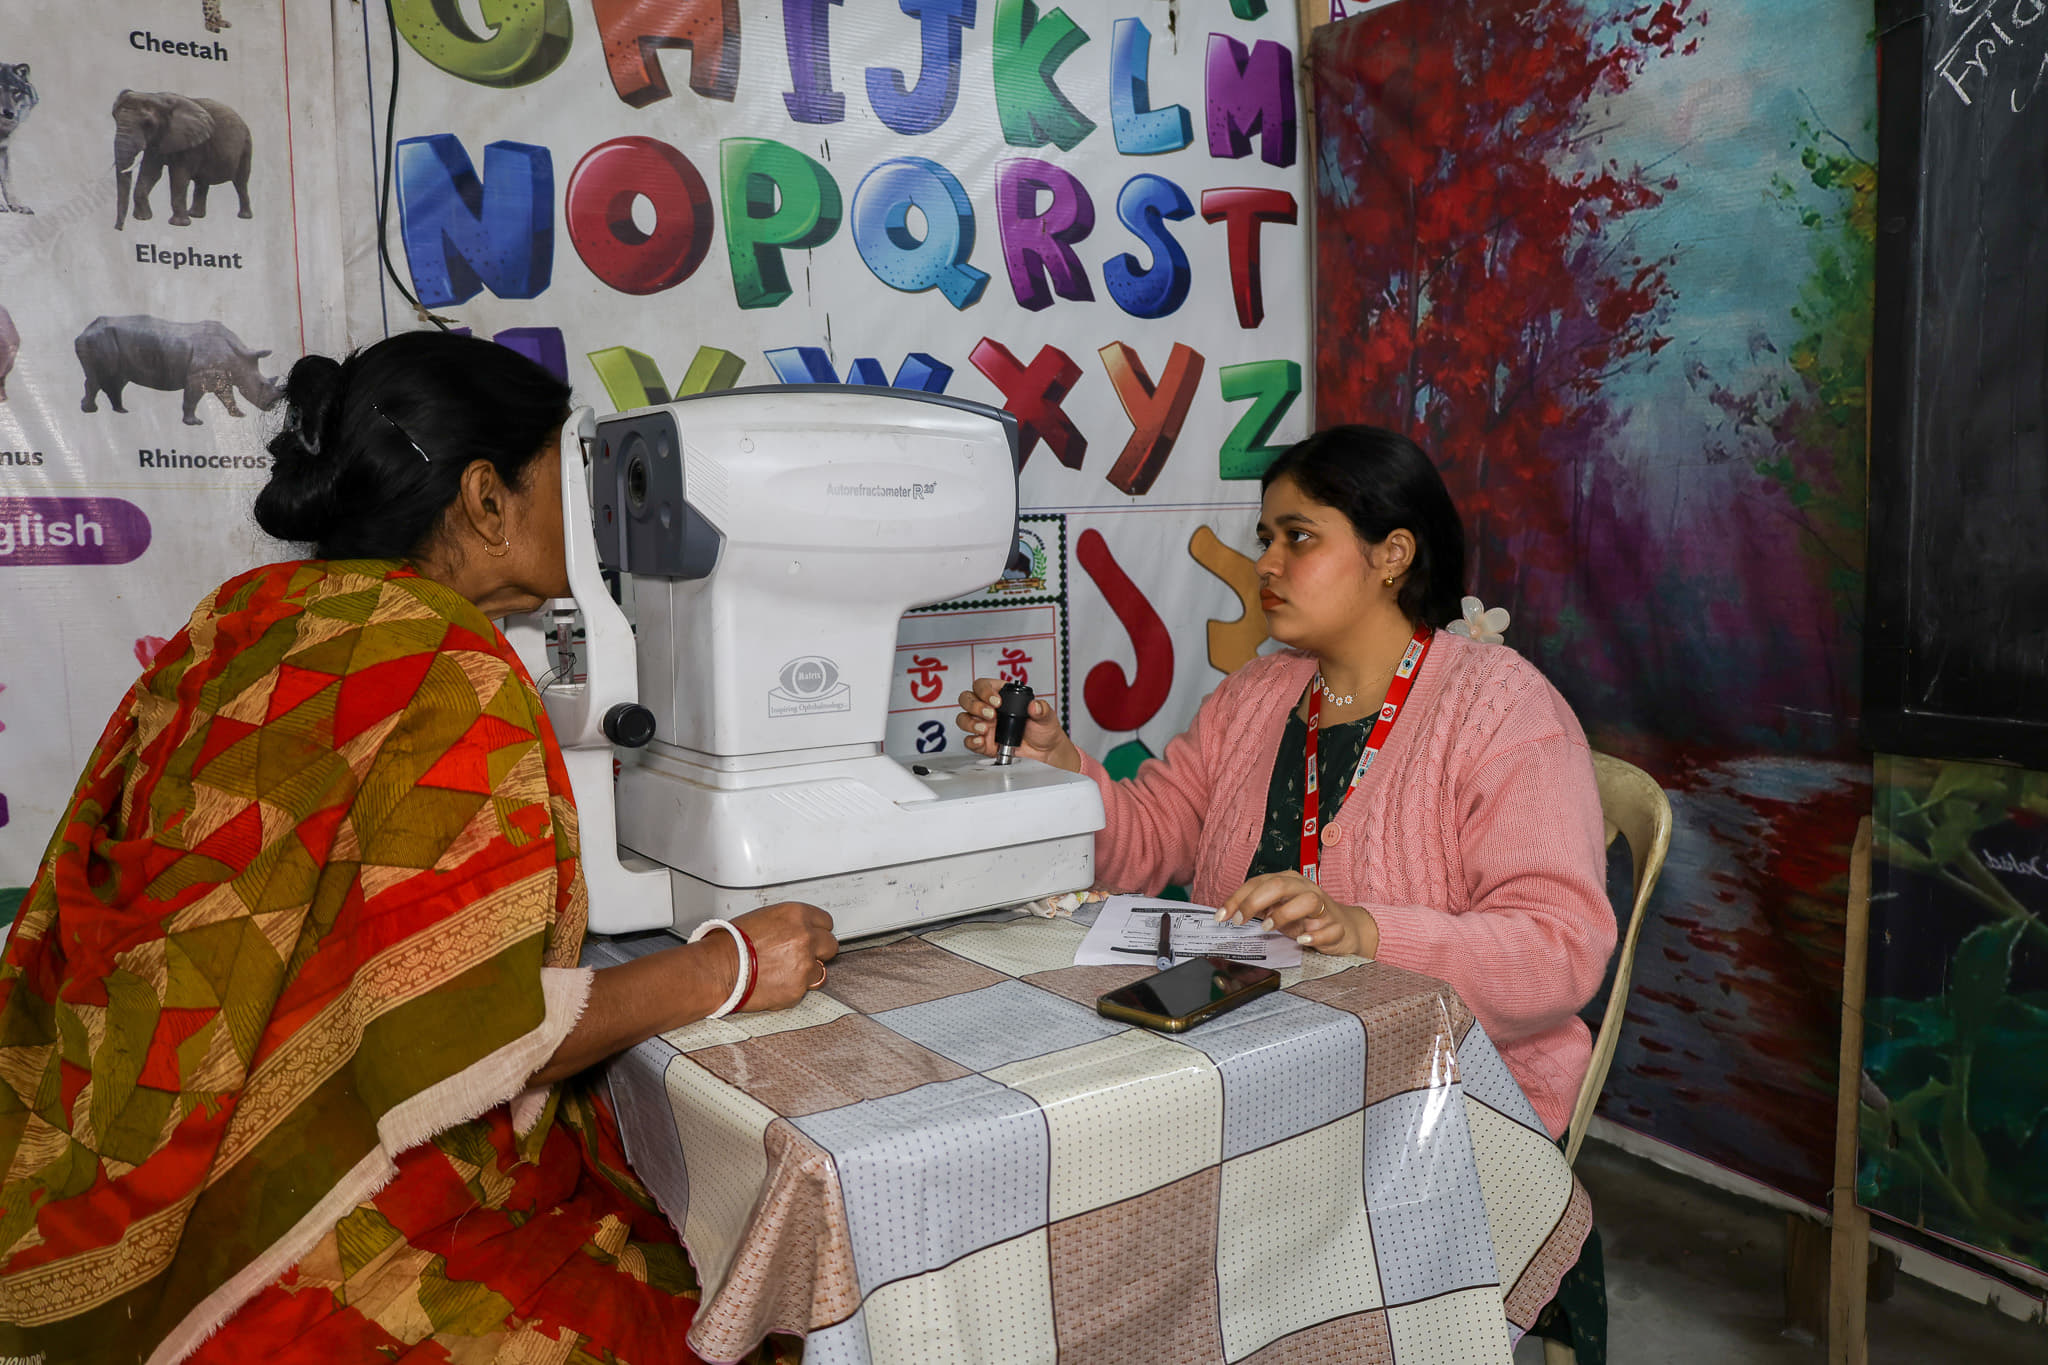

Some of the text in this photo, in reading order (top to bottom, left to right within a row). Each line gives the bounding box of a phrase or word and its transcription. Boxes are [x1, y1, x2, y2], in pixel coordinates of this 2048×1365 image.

[129, 31, 228, 61] Cheetah
[993, 0, 1097, 152] K
[1109, 17, 1194, 155] L
[1205, 32, 1297, 168] M
[135, 244, 243, 269] Elephant
[395, 133, 1298, 329] N O P Q R S T
[138, 449, 268, 469] Rhinoceros
[1097, 340, 1205, 496] Y
[1219, 359, 1302, 480] Z
